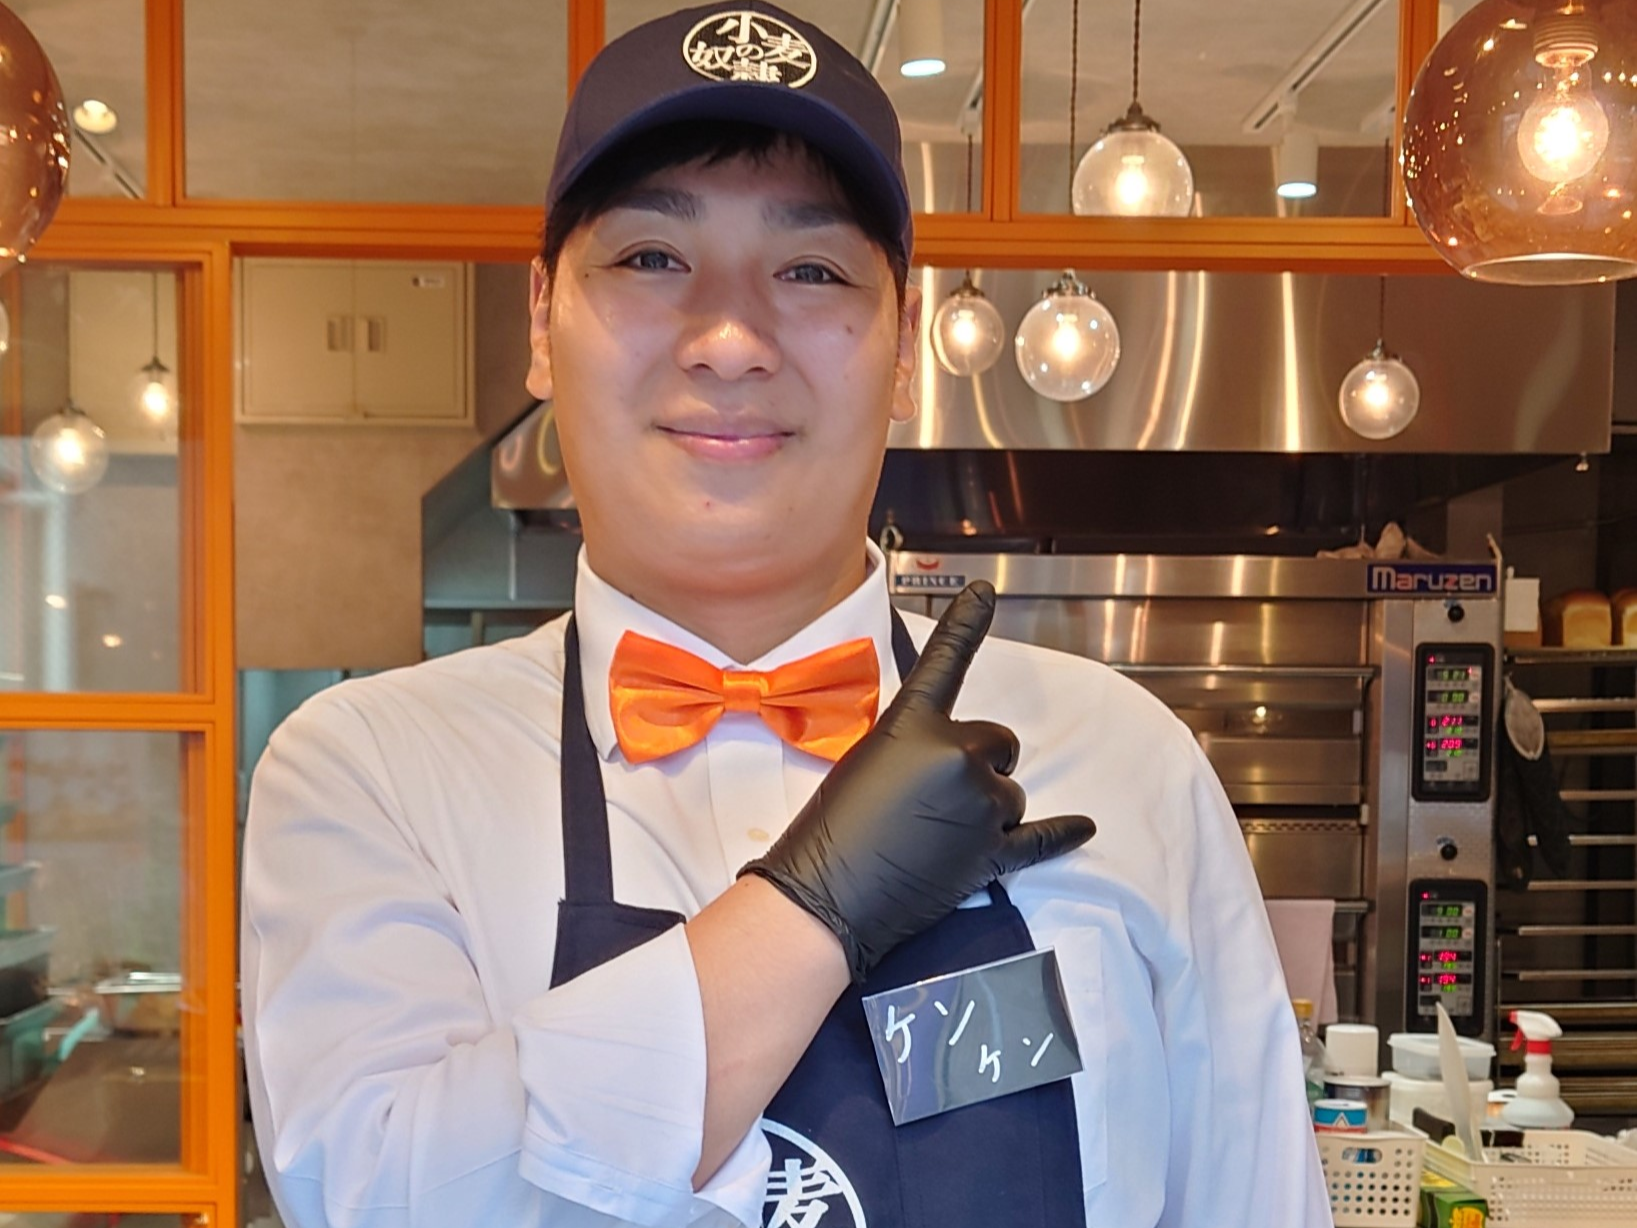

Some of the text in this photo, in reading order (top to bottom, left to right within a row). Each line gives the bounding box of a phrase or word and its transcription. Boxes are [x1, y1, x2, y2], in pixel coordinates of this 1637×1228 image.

[1372, 566, 1492, 591] Maruzen
[885, 1000, 975, 1063] ケン
[978, 1032, 1054, 1083] ケン
